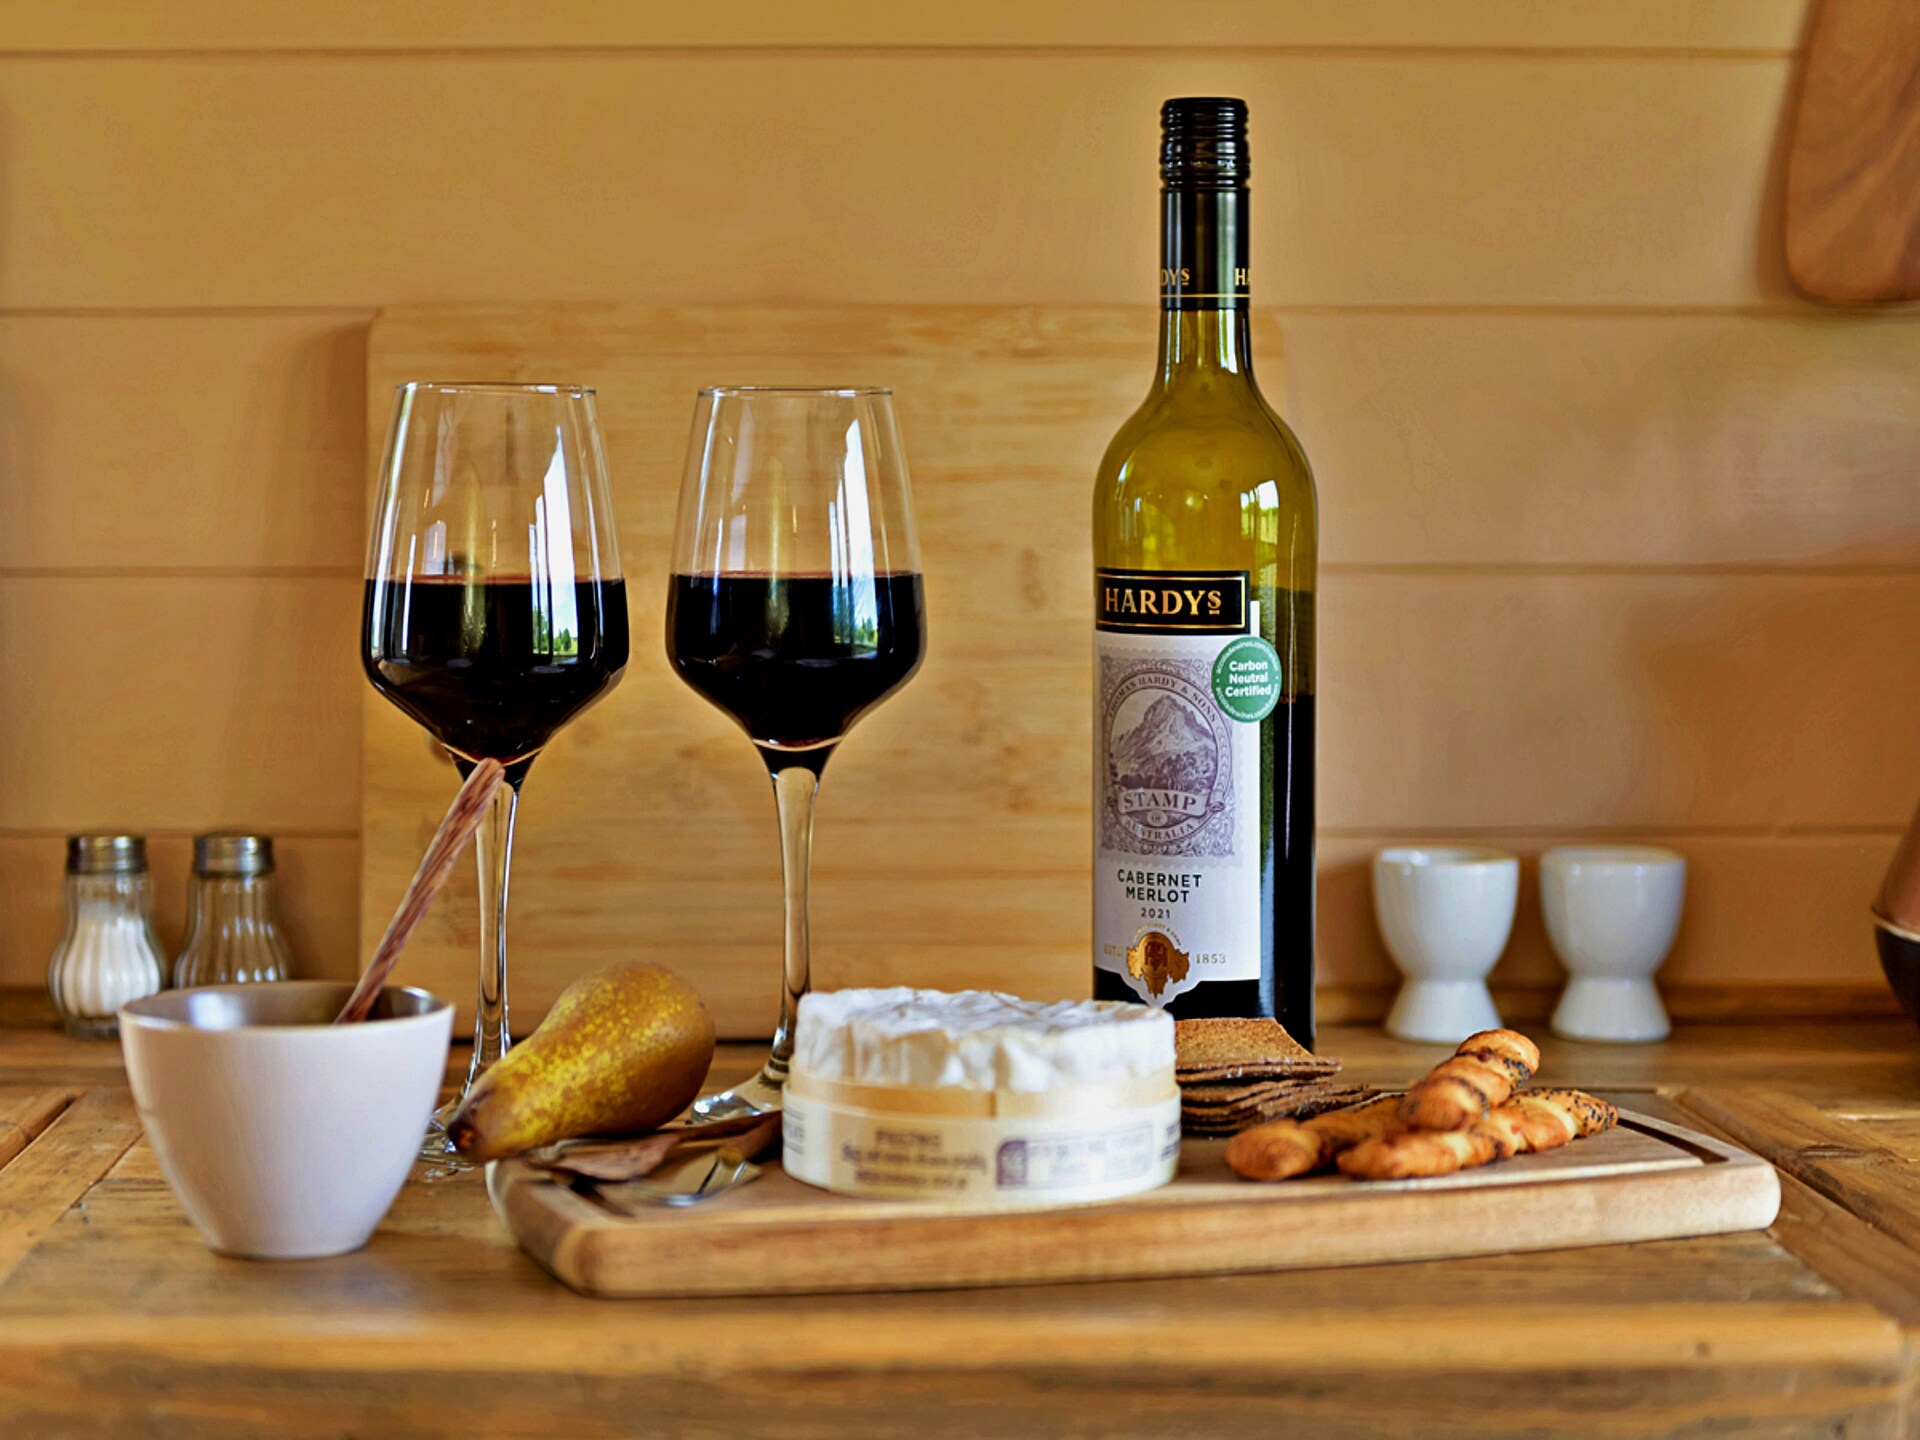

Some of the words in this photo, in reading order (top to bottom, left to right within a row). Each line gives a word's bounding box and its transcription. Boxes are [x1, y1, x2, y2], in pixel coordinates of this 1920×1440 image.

[1229, 660, 1268, 671] Carbon
[1229, 672, 1268, 684] Neutral
[1225, 684, 1272, 697] Certified
[1138, 676, 1177, 688] HARDY
[1181, 686, 1188, 694] &
[1192, 692, 1216, 722] SONS
[1124, 792, 1196, 810] STAMP
[1117, 869, 1202, 888] CABERNET
[1126, 886, 1190, 903] MERLOT
[1141, 907, 1170, 918] 2021
[1196, 953, 1226, 964] 1853
